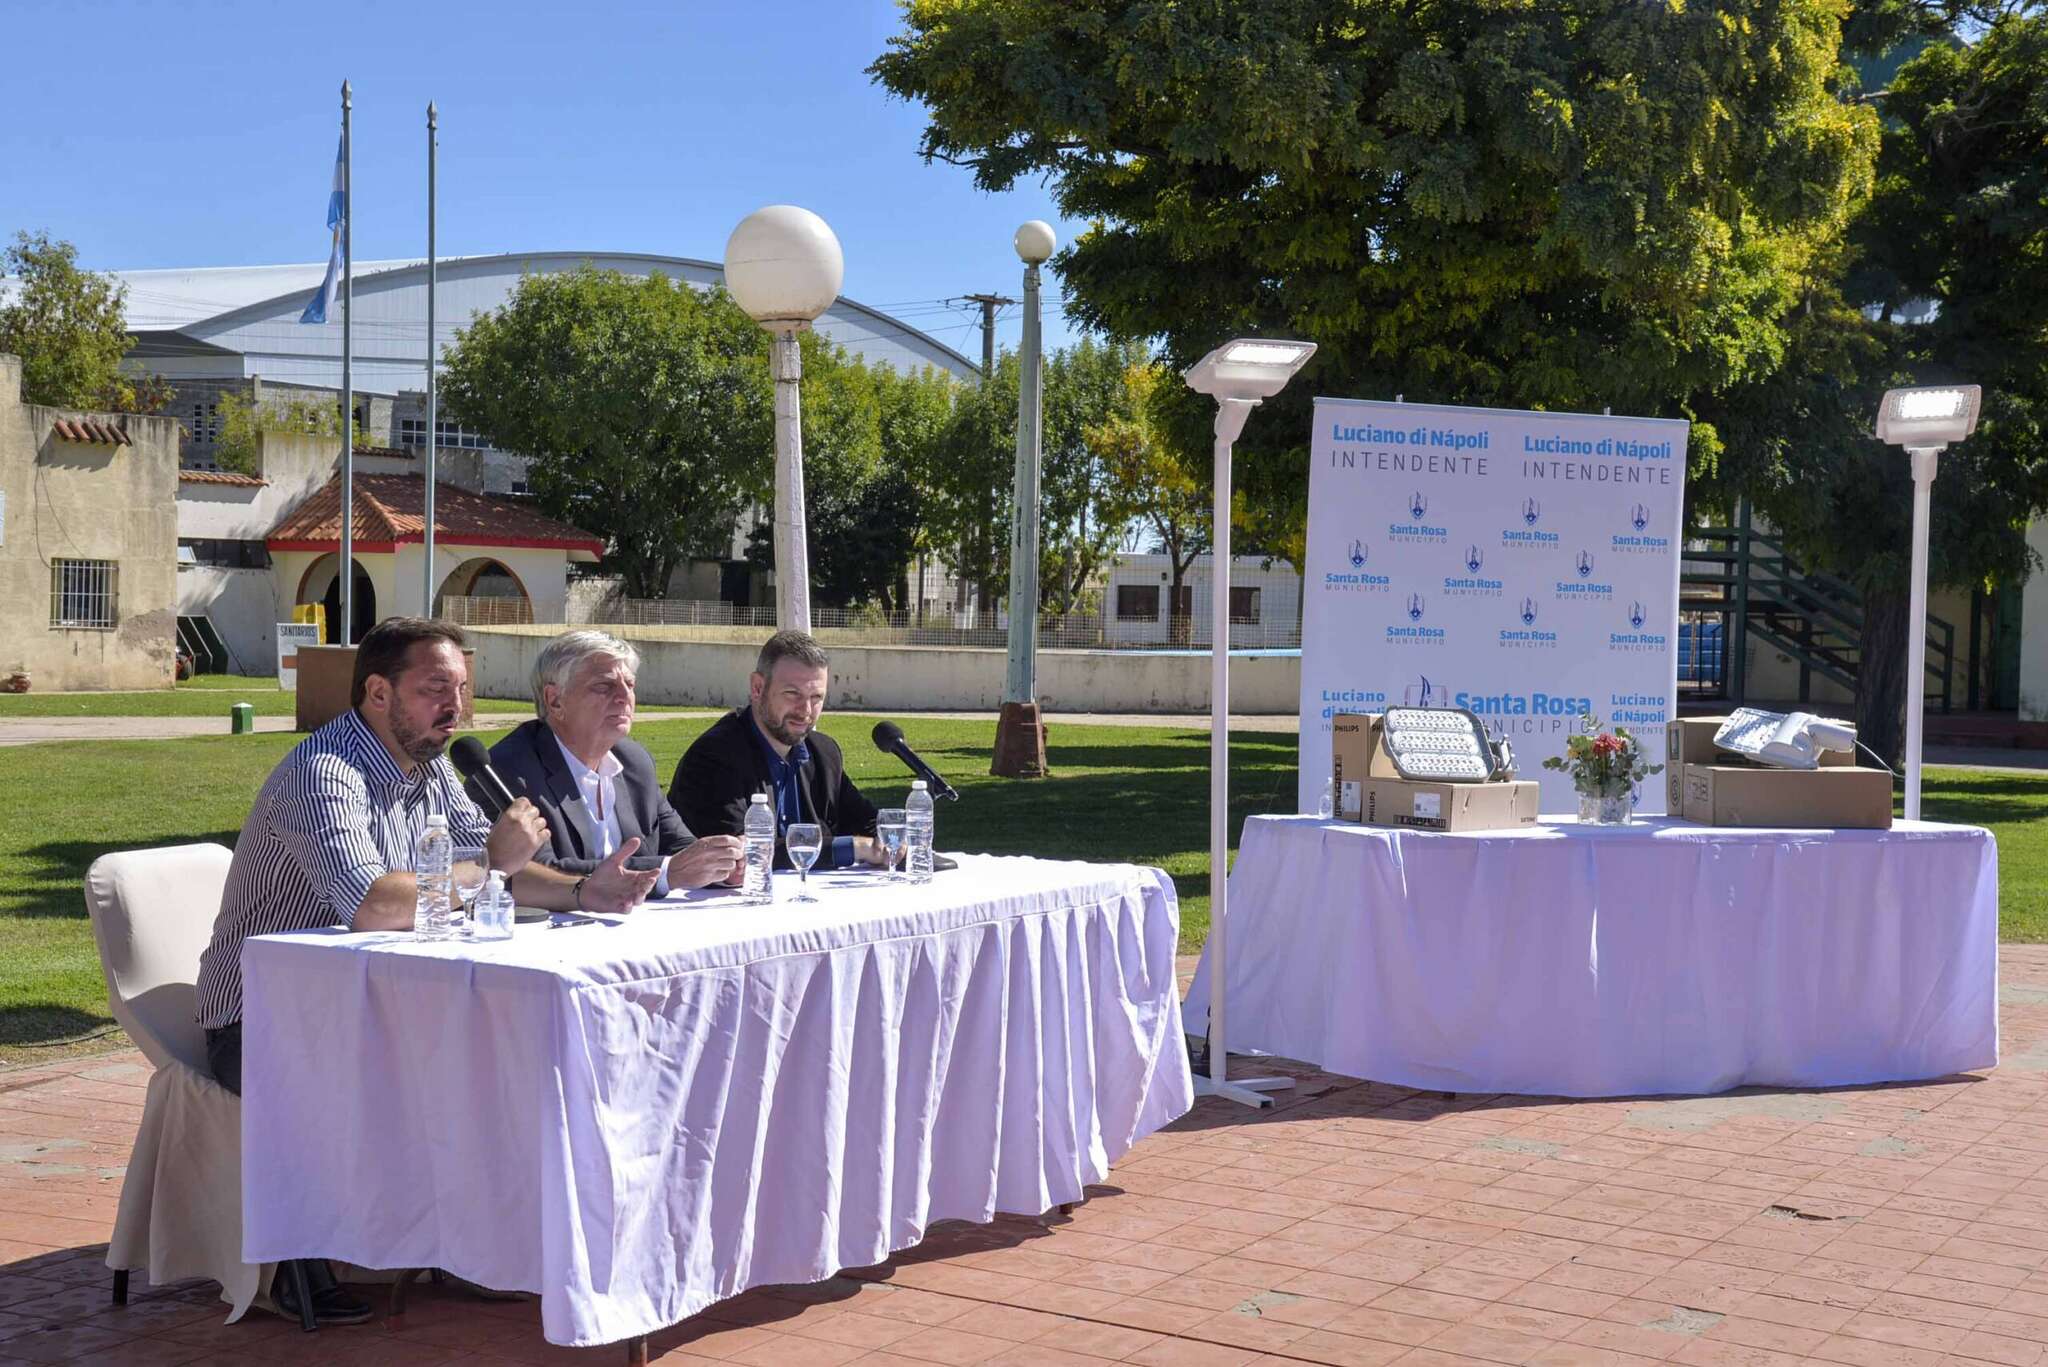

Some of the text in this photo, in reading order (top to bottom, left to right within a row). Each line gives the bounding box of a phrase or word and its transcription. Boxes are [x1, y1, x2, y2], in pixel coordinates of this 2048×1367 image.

[1333, 424, 1488, 451] Luciano di Nápoli
[1524, 435, 1671, 461] Luciano di Nápoli
[1331, 450, 1488, 476] INTENDENTE
[1523, 461, 1671, 485] INTENDENTE
[1389, 524, 1447, 536] Santa Rosa
[1502, 530, 1559, 541] Santa Rosa
[1389, 535, 1448, 544] MUNICIPIO
[1502, 540, 1559, 550] MUNICIPIO
[1612, 535, 1667, 546] Santa Rosa
[1611, 546, 1668, 555] MUNICIPIO
[1325, 573, 1389, 585] Santa Rosa
[1444, 577, 1503, 589] Santa Rosa
[1325, 583, 1390, 593] MUNICIPIO
[1443, 588, 1502, 597] MUNICIPIO
[1556, 582, 1612, 593] Santa Rosa
[1555, 592, 1612, 601] MUNICIPIO
[1386, 626, 1444, 637] Santa Rosa
[1500, 630, 1557, 641] Santa Rosa
[1386, 637, 1444, 646] MUNICIPIO
[1610, 633, 1665, 644] Santa Rosa
[1499, 640, 1557, 649] MUNICIPIO
[1609, 643, 1665, 653] MUNICIPIO
[1322, 689, 1385, 702] Luciano
[1611, 693, 1664, 706] Luciano
[1455, 692, 1591, 716] Santa Rosa
[1611, 710, 1664, 724] di Nápoli
[1334, 724, 1360, 732] PHILIPS
[1483, 719, 1592, 734] NICIPIO
[1368, 791, 1376, 822] PHILIPS
